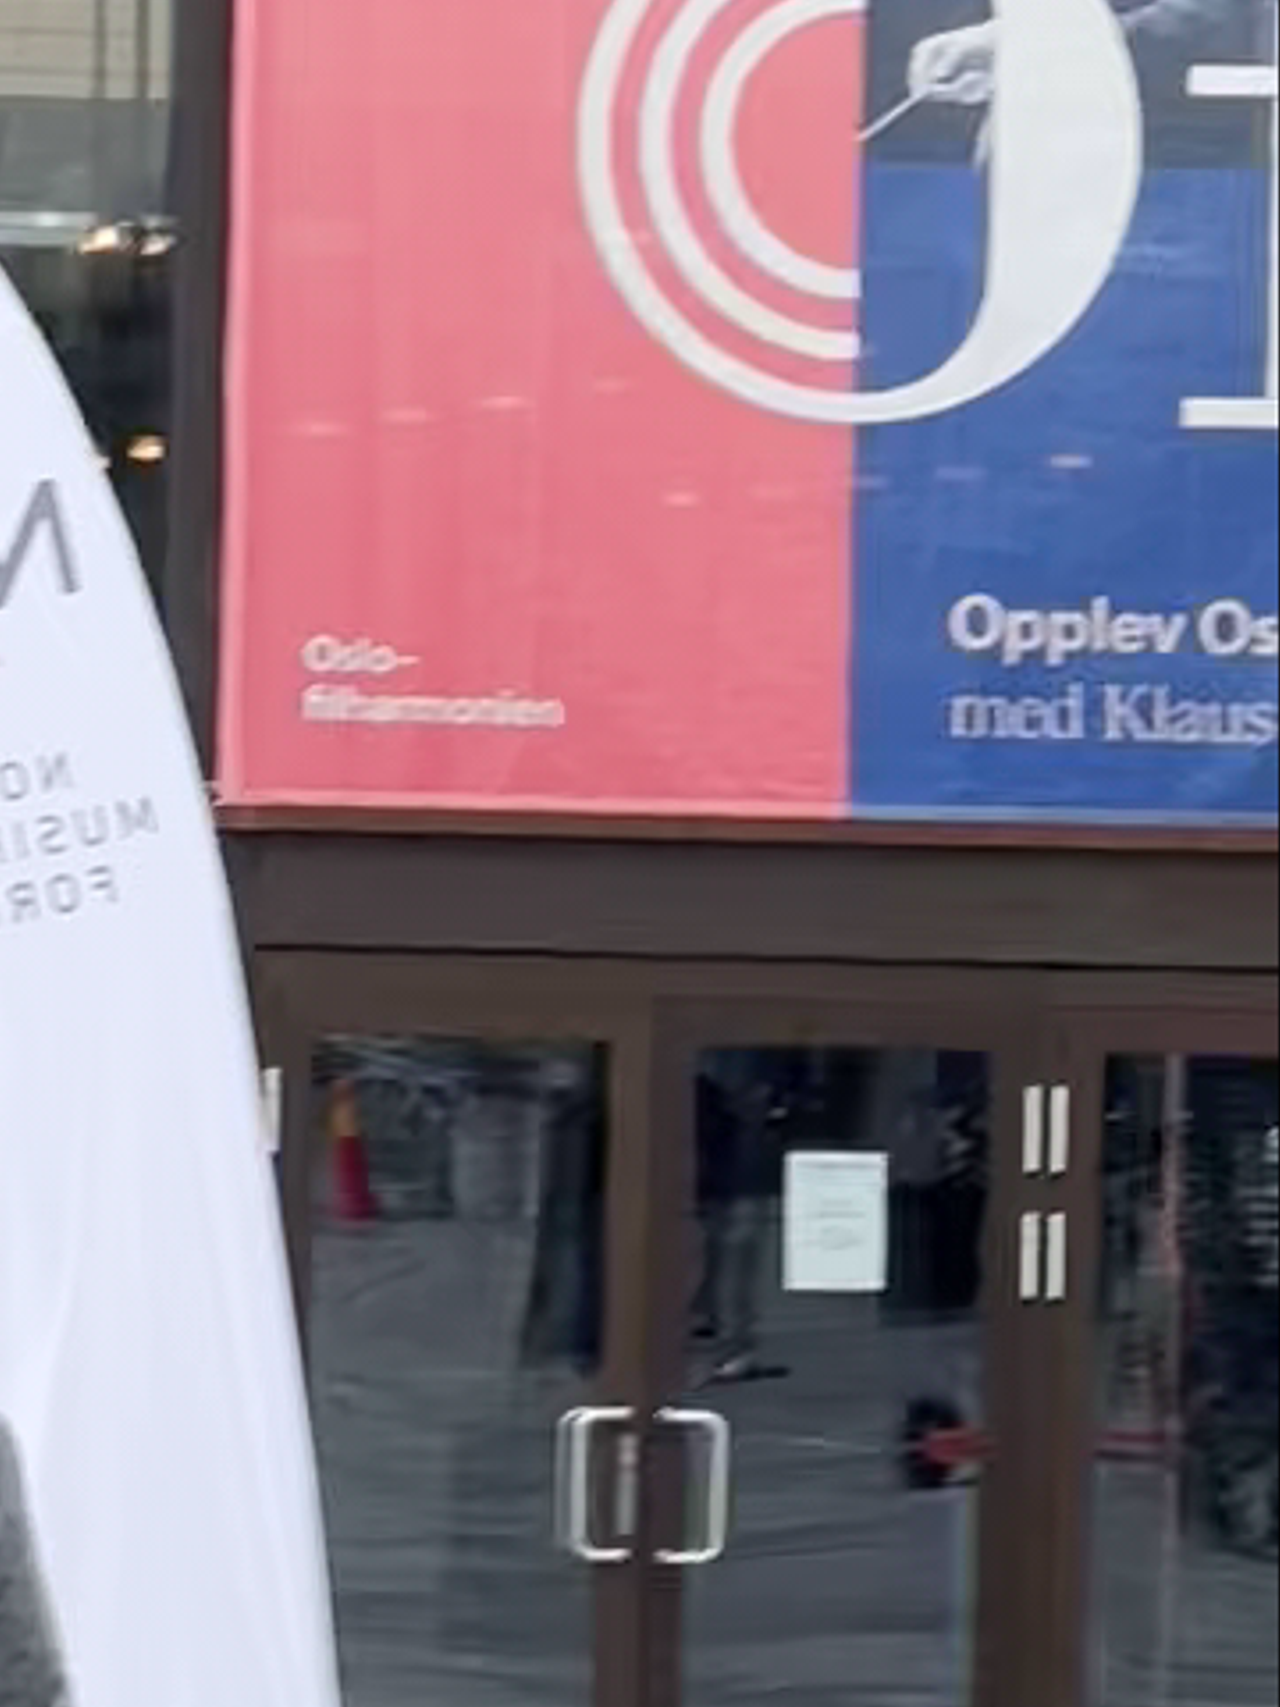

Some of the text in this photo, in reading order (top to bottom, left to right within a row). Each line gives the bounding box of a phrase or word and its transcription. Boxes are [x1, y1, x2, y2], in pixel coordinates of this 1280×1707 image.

[948, 593, 1188, 667] Opplev
[950, 682, 1278, 745] med Klaus
